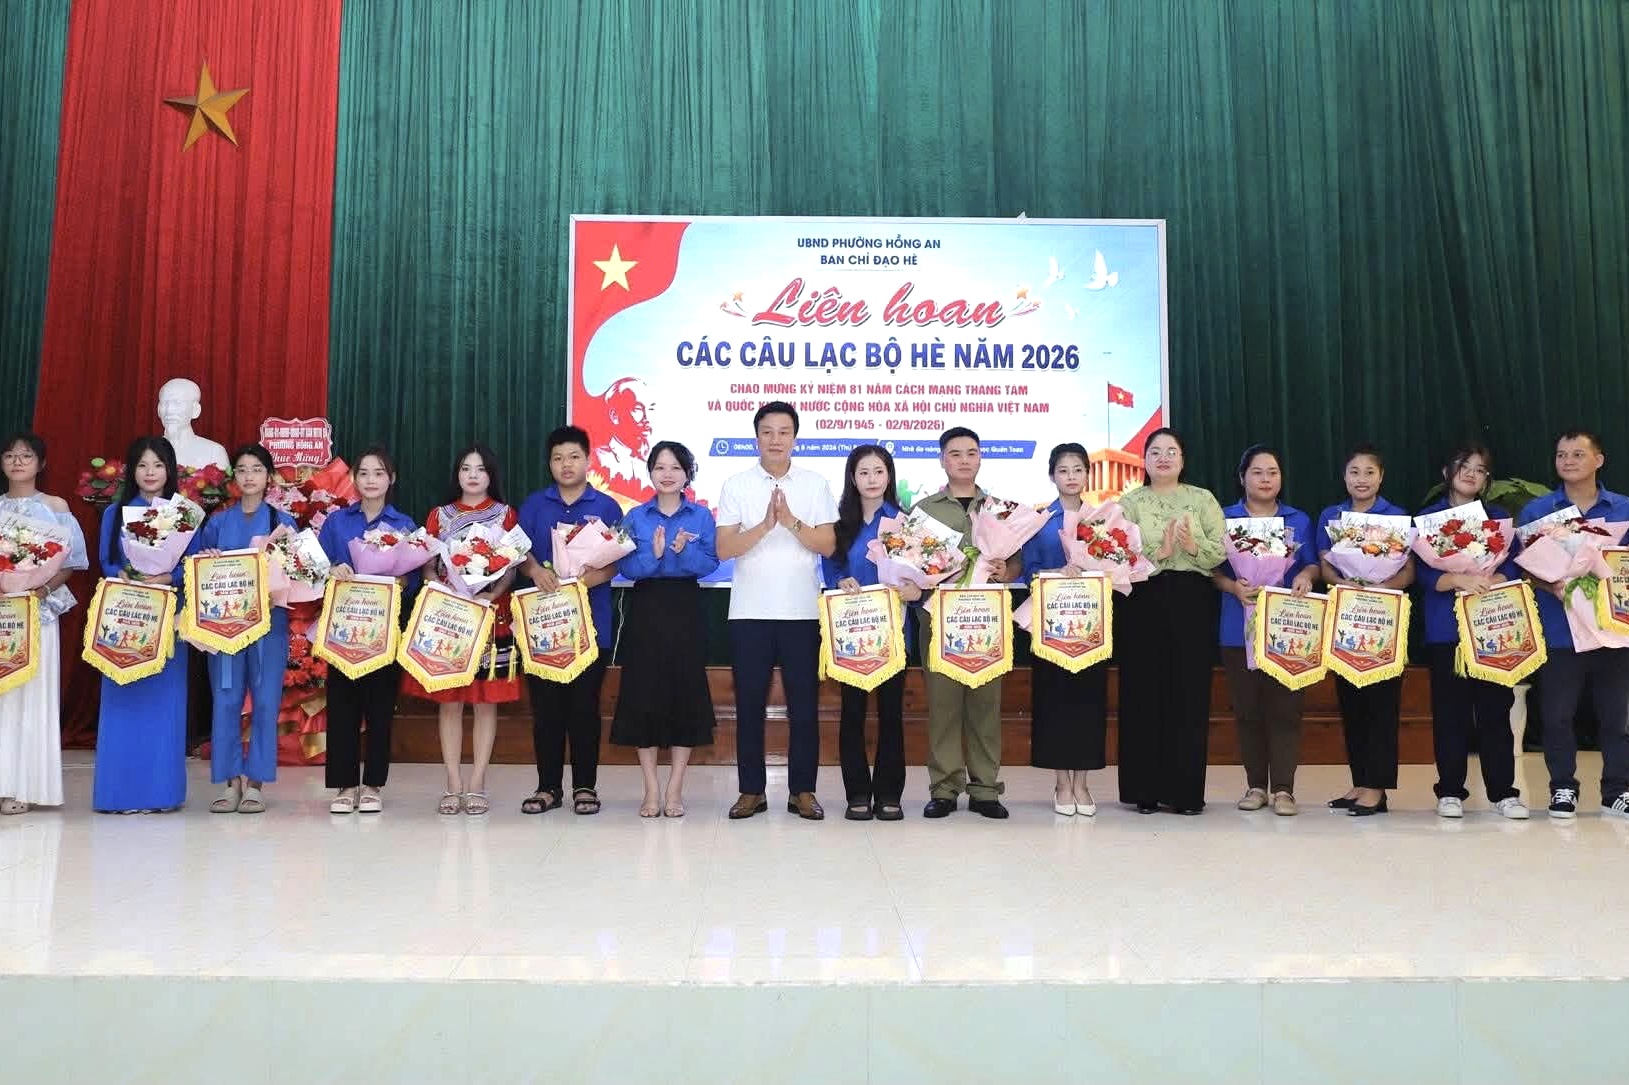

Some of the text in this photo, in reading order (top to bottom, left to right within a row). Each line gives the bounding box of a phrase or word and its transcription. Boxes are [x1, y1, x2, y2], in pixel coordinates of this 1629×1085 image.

[797, 234, 940, 249] UBND PHƯỜNG HỒNG AN
[820, 255, 844, 265] BAN
[873, 255, 900, 268] ĐẠO
[903, 252, 918, 266] HÈ
[752, 277, 1005, 328] Liên hoan
[676, 335, 1080, 374] CÁC CÂU LẠC BỘ HÈ NĂM 2026
[850, 384, 862, 394] 81
[816, 419, 874, 430] (02/9/1945
